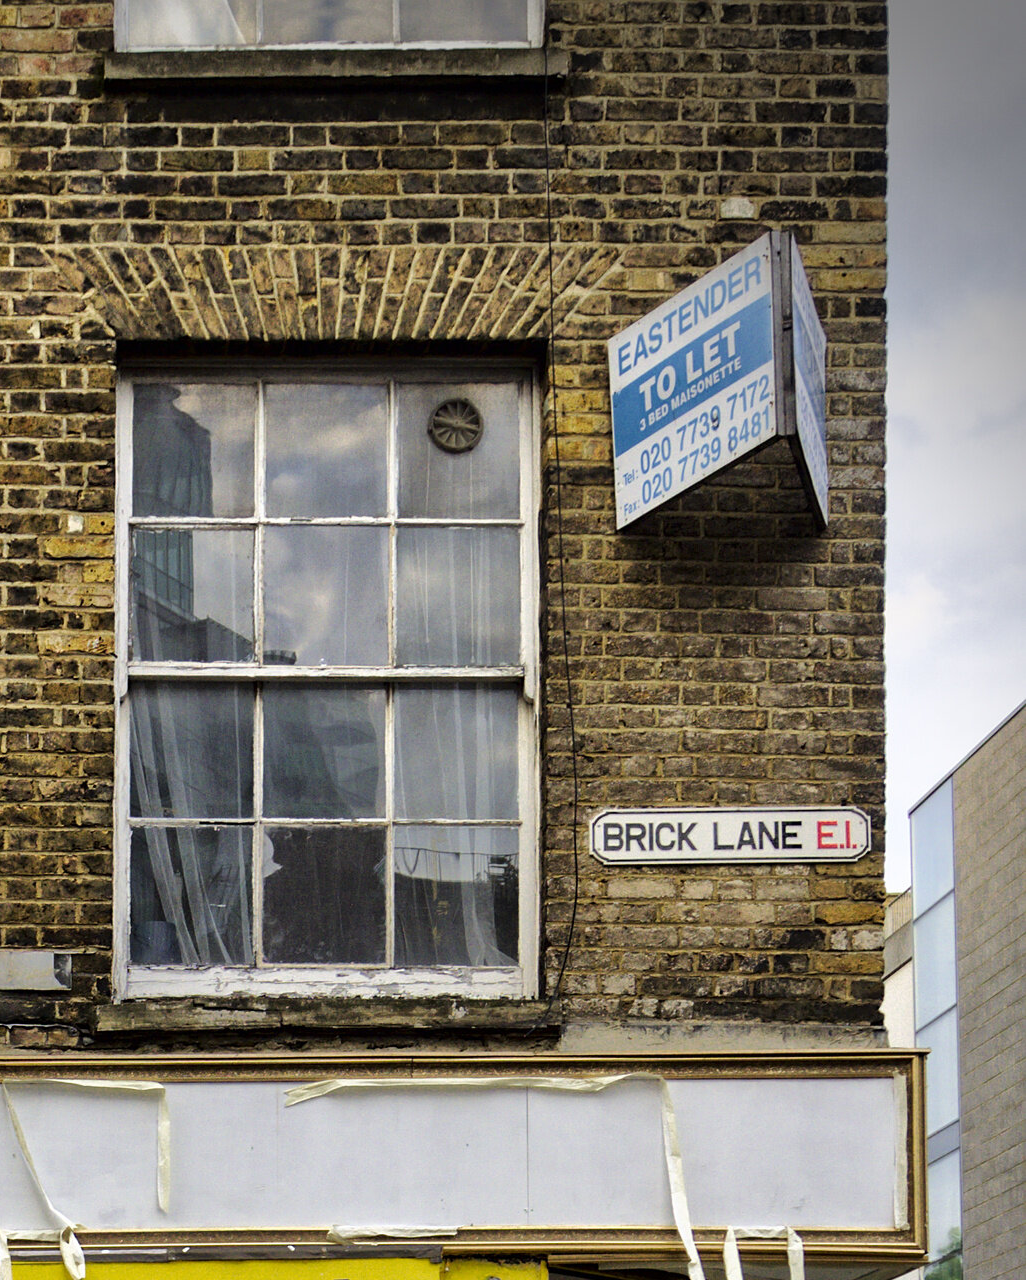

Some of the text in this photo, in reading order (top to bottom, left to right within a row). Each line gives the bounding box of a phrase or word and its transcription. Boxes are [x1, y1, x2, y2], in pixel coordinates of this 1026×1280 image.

[618, 255, 762, 376] EASTENDER
[639, 321, 741, 412] TO LET
[640, 356, 742, 431] 3 BED MAISONETTE
[640, 436, 671, 474] 020
[676, 405, 722, 451] 7739
[726, 374, 770, 417] 7172
[642, 466, 673, 505] 020
[678, 436, 722, 482] 7739
[728, 406, 771, 452] 8481
[603, 822, 698, 851] BRICK
[713, 821, 802, 850] LANE
